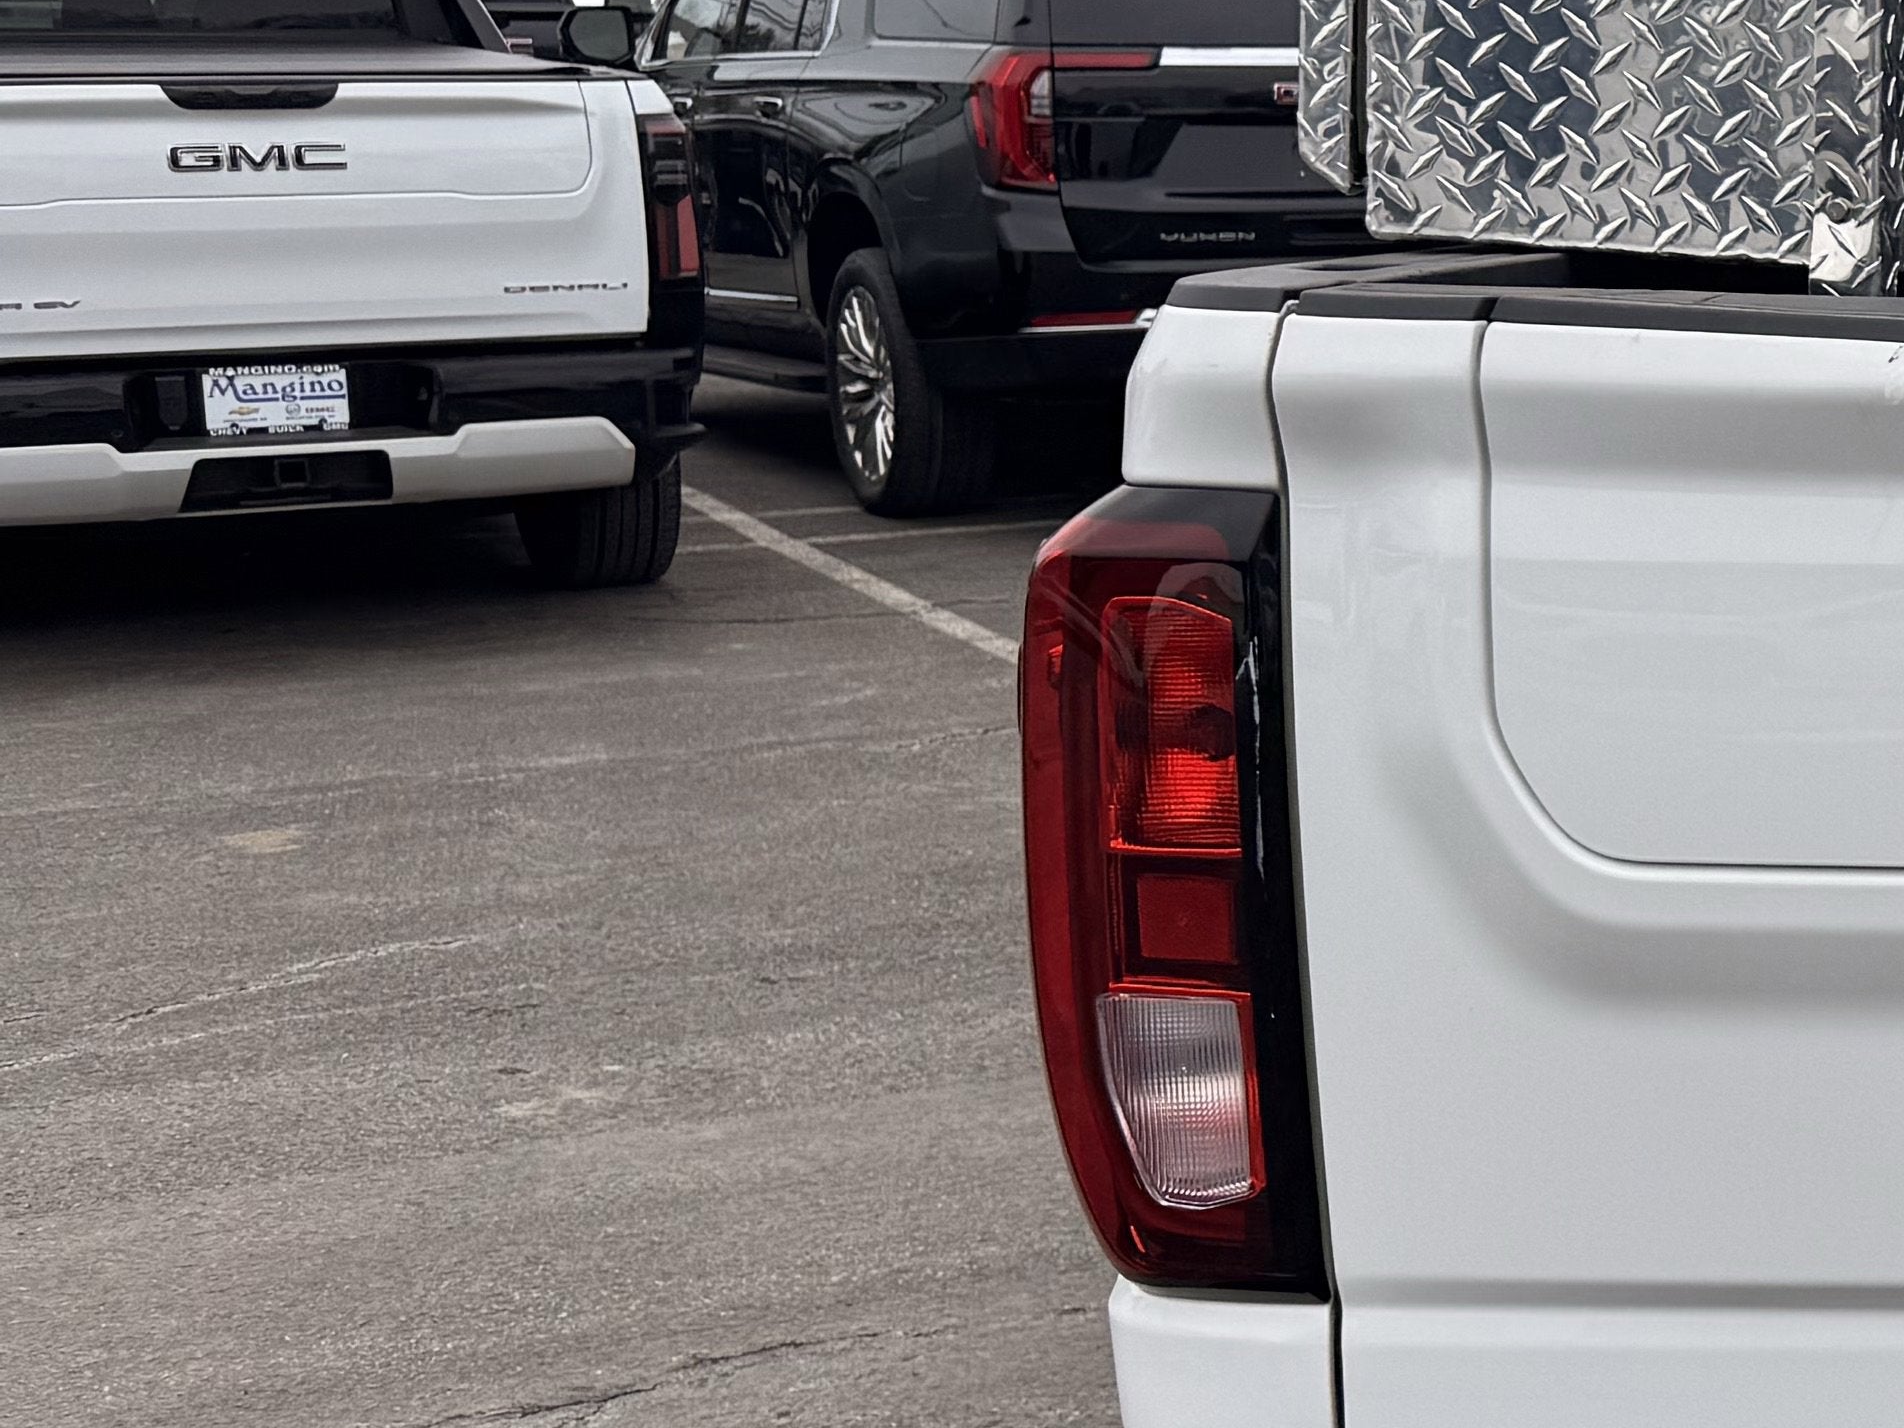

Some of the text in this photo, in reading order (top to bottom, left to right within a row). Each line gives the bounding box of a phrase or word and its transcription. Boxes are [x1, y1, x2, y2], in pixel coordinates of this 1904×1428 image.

[167, 142, 347, 172] GMC
[503, 283, 628, 293] DENALI
[208, 375, 344, 402] Mangino
